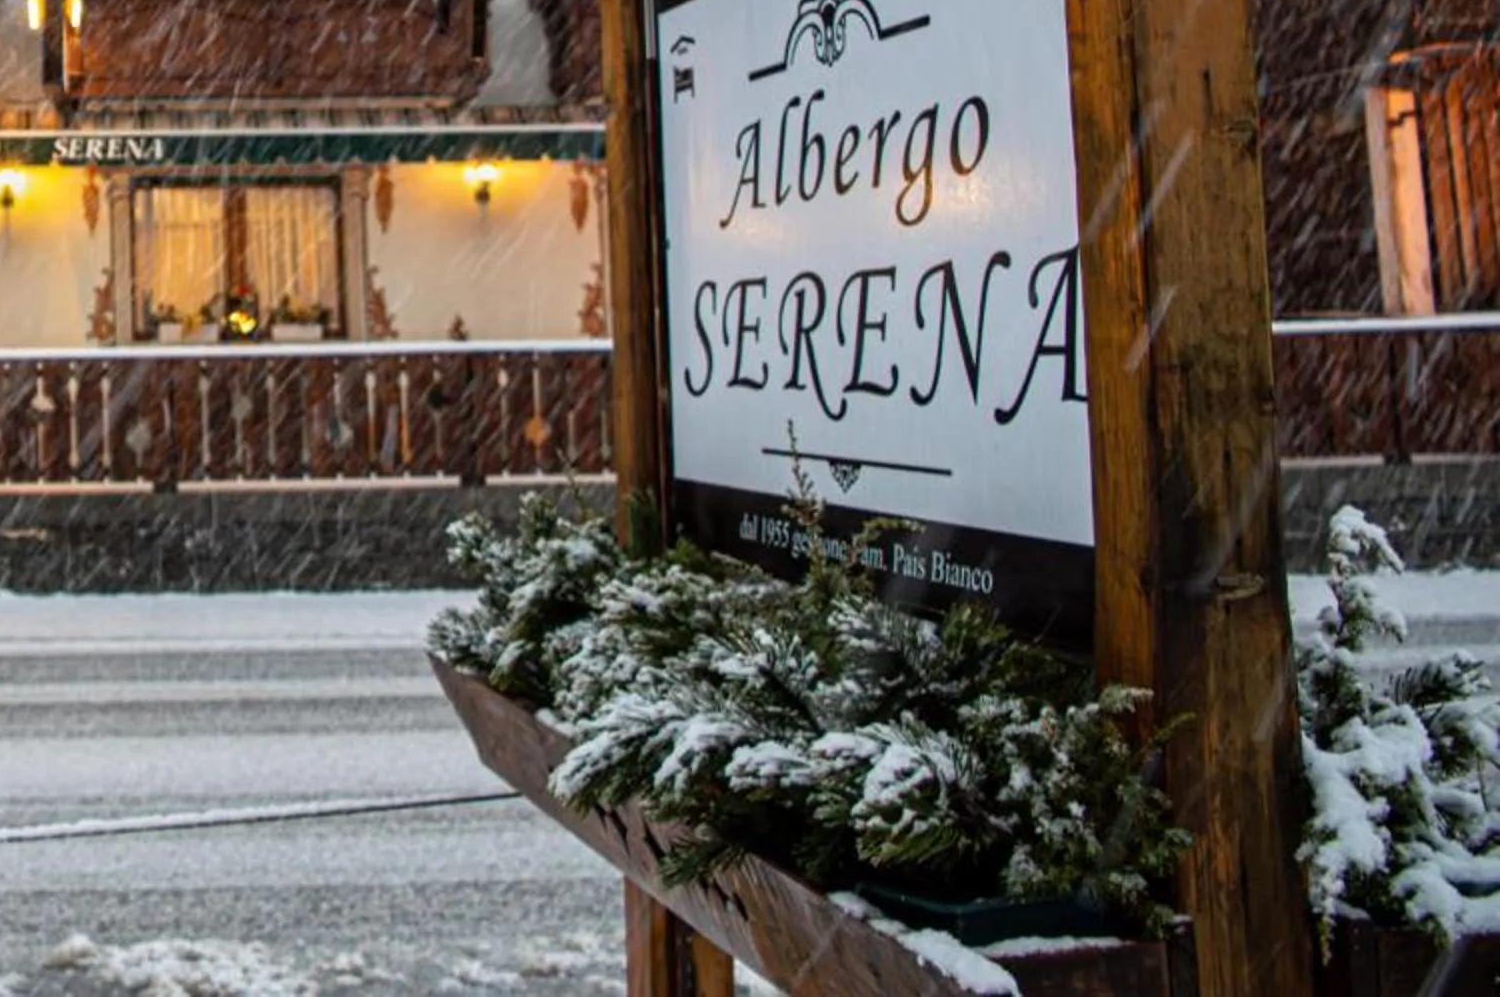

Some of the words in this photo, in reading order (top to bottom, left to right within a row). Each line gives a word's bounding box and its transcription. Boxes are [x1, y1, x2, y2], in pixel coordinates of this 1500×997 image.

[52, 137, 163, 160] SERENA
[719, 89, 990, 226] Albergo
[684, 243, 1088, 425] SERENA
[739, 512, 758, 541] dal
[760, 515, 790, 548] 1955
[892, 542, 927, 580] Pais
[931, 550, 993, 594] Bianco
